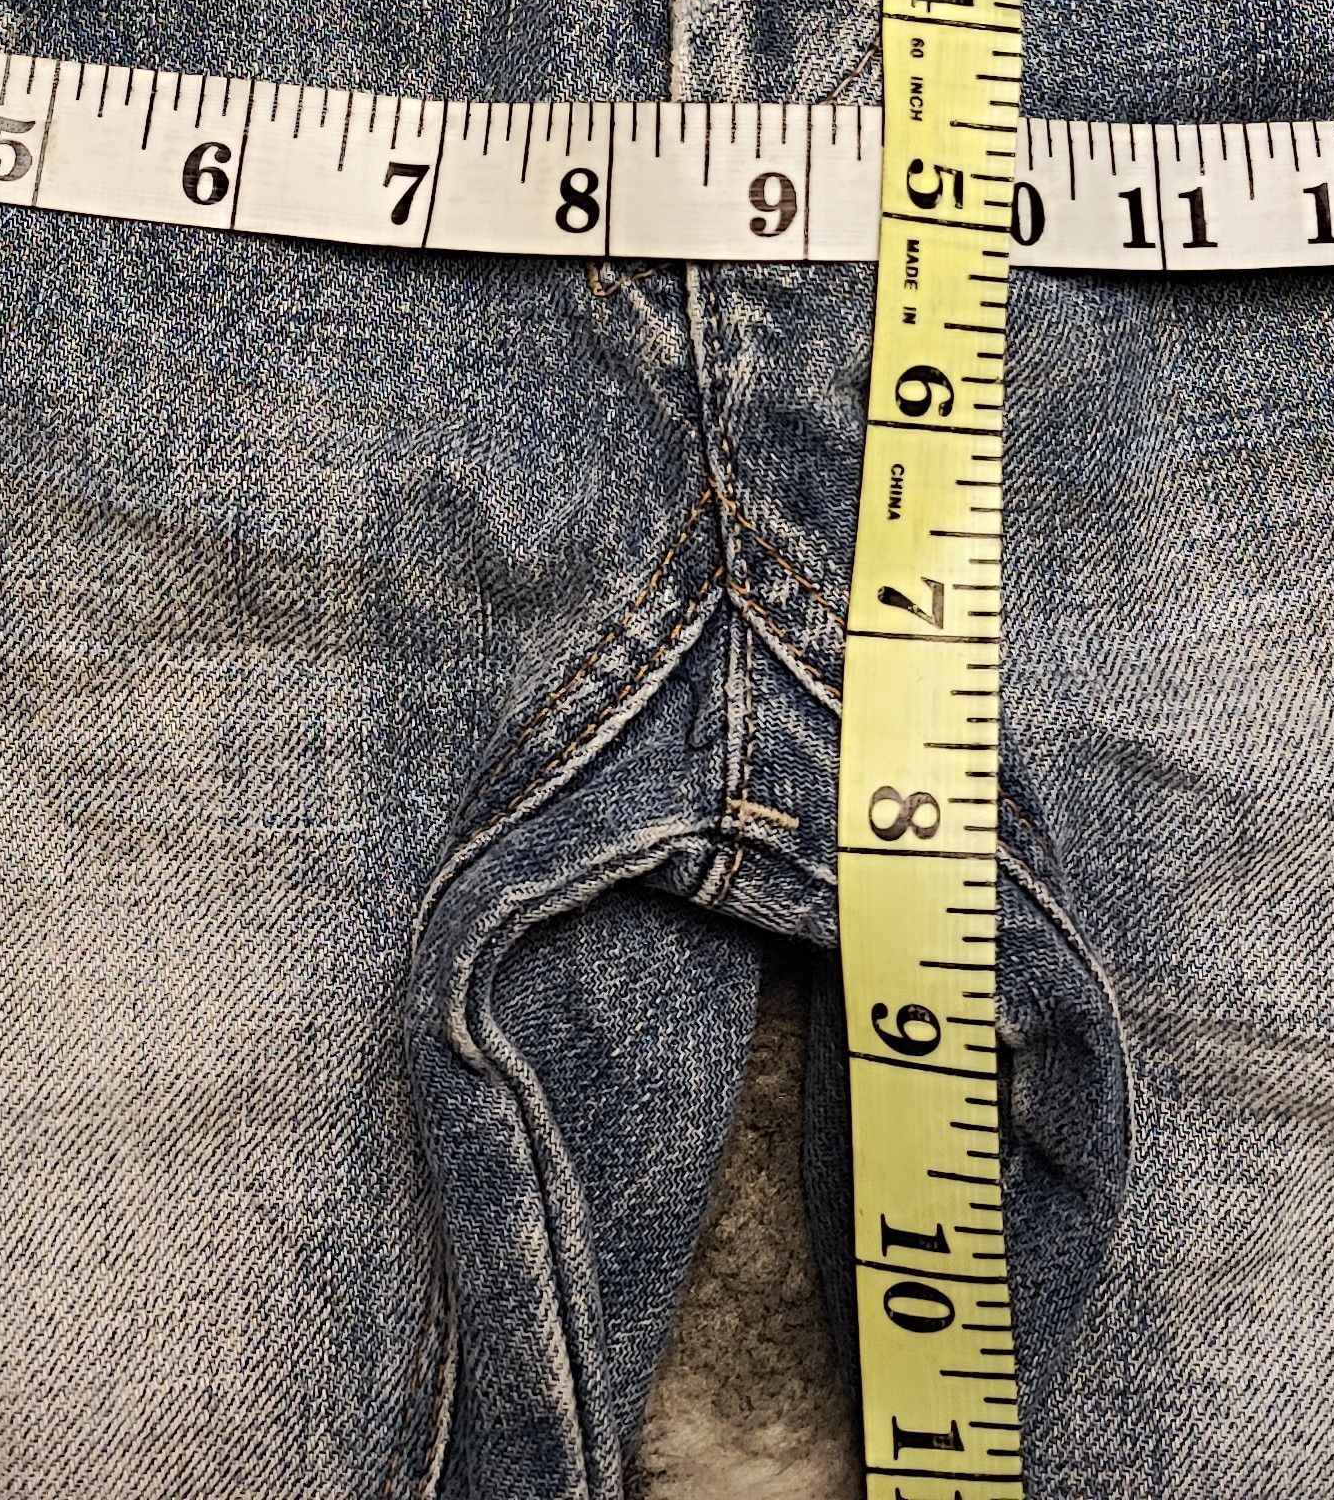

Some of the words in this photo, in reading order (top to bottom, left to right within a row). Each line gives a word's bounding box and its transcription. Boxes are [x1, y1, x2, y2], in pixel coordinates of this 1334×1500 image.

[911, 37, 925, 59] 60
[910, 76, 924, 122] INCH
[182, 141, 232, 206] 6
[383, 161, 431, 226] 7
[555, 167, 600, 234] 8
[748, 172, 798, 238] 9
[1011, 181, 1045, 246] 0
[1118, 184, 1219, 249] 11
[906, 158, 964, 210] 5
[904, 239, 920, 291] MADE
[902, 306, 916, 325] IN
[895, 364, 955, 417] 6
[887, 463, 905, 521] CHINA
[877, 576, 944, 629] 7
[868, 785, 941, 841] 8
[871, 1002, 941, 1057] 9
[880, 1213, 955, 1333] 10
